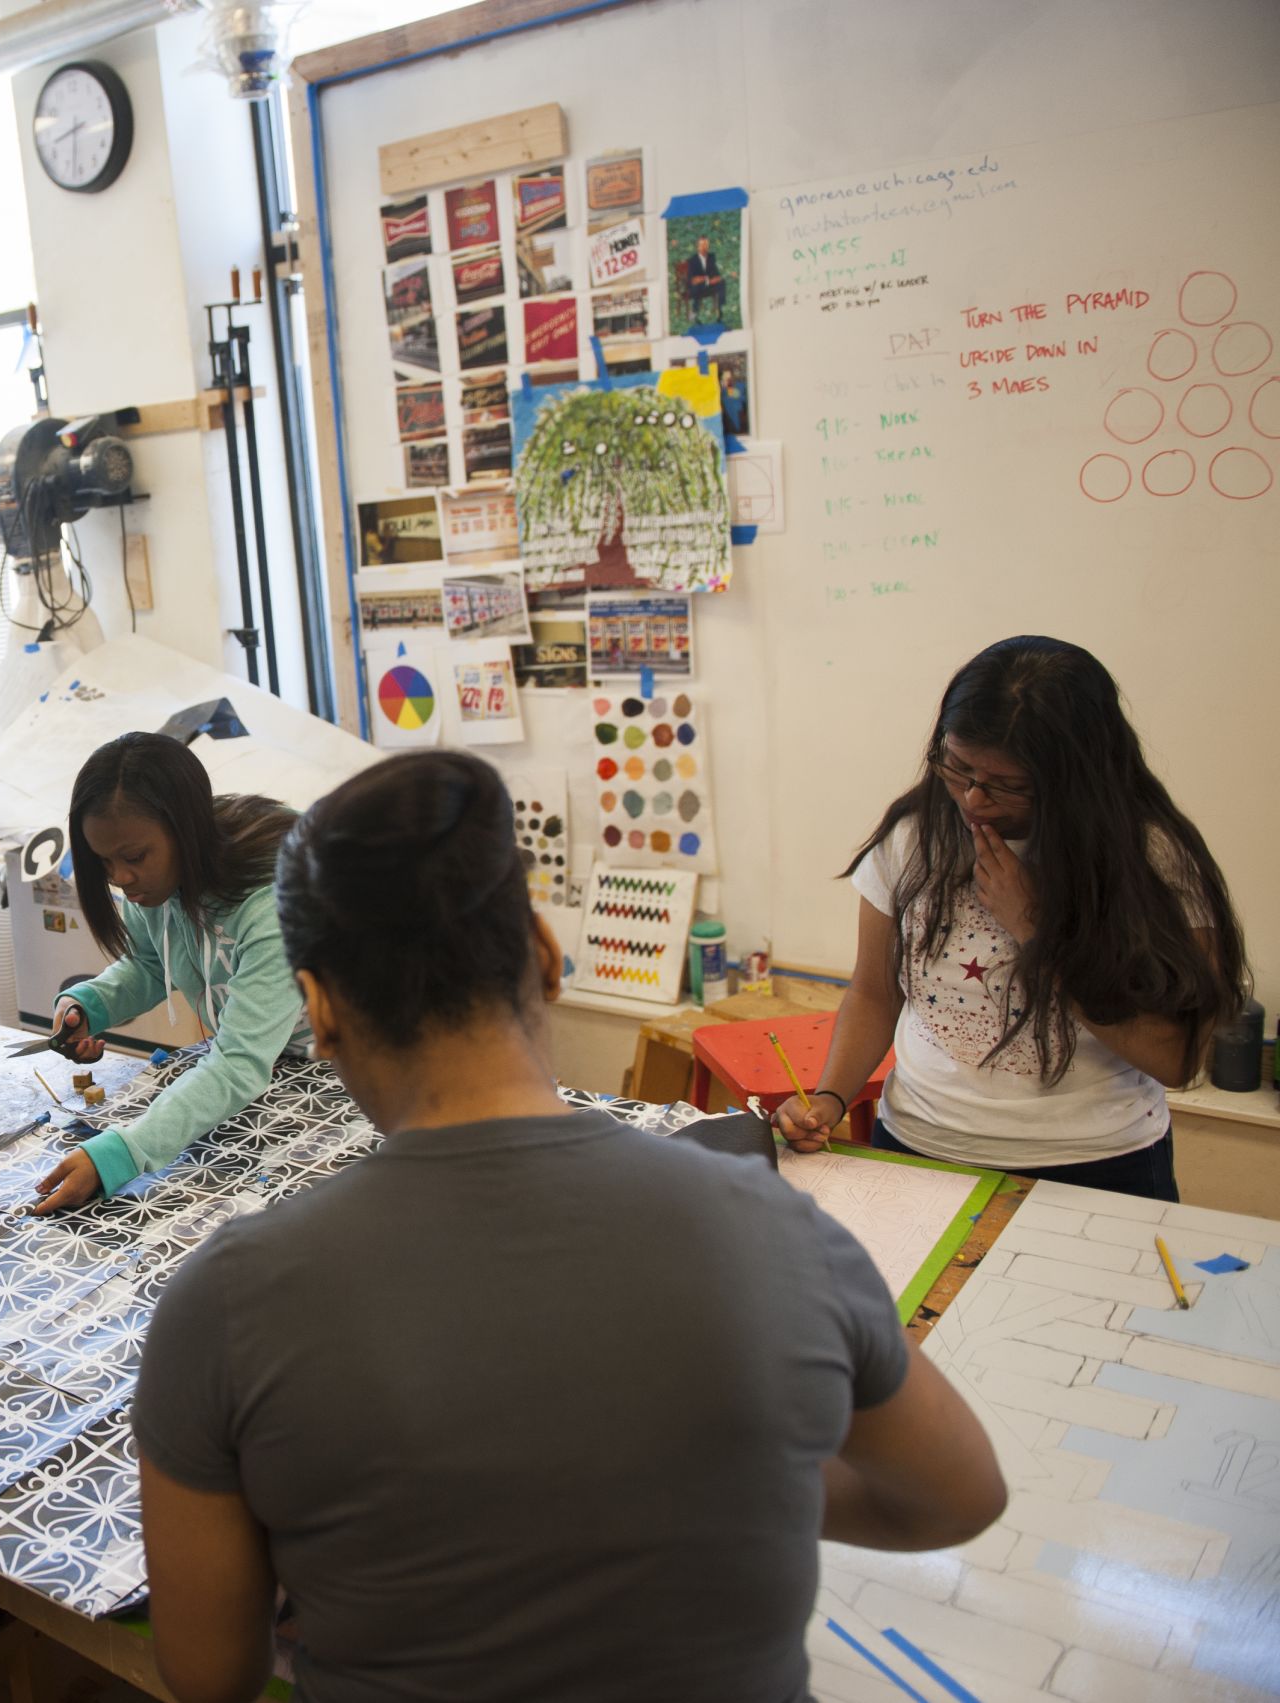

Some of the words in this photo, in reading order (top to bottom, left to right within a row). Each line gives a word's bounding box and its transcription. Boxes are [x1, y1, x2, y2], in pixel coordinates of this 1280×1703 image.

[959, 307, 1003, 329] TURN
[1010, 303, 1048, 323] THE
[1066, 288, 1150, 315] PYRAMID
[959, 347, 1017, 368] UPSIDE
[1026, 340, 1067, 361] DOWN
[1077, 335, 1099, 355] IN
[967, 381, 982, 400] 3
[536, 646, 578, 663] SIGNS
